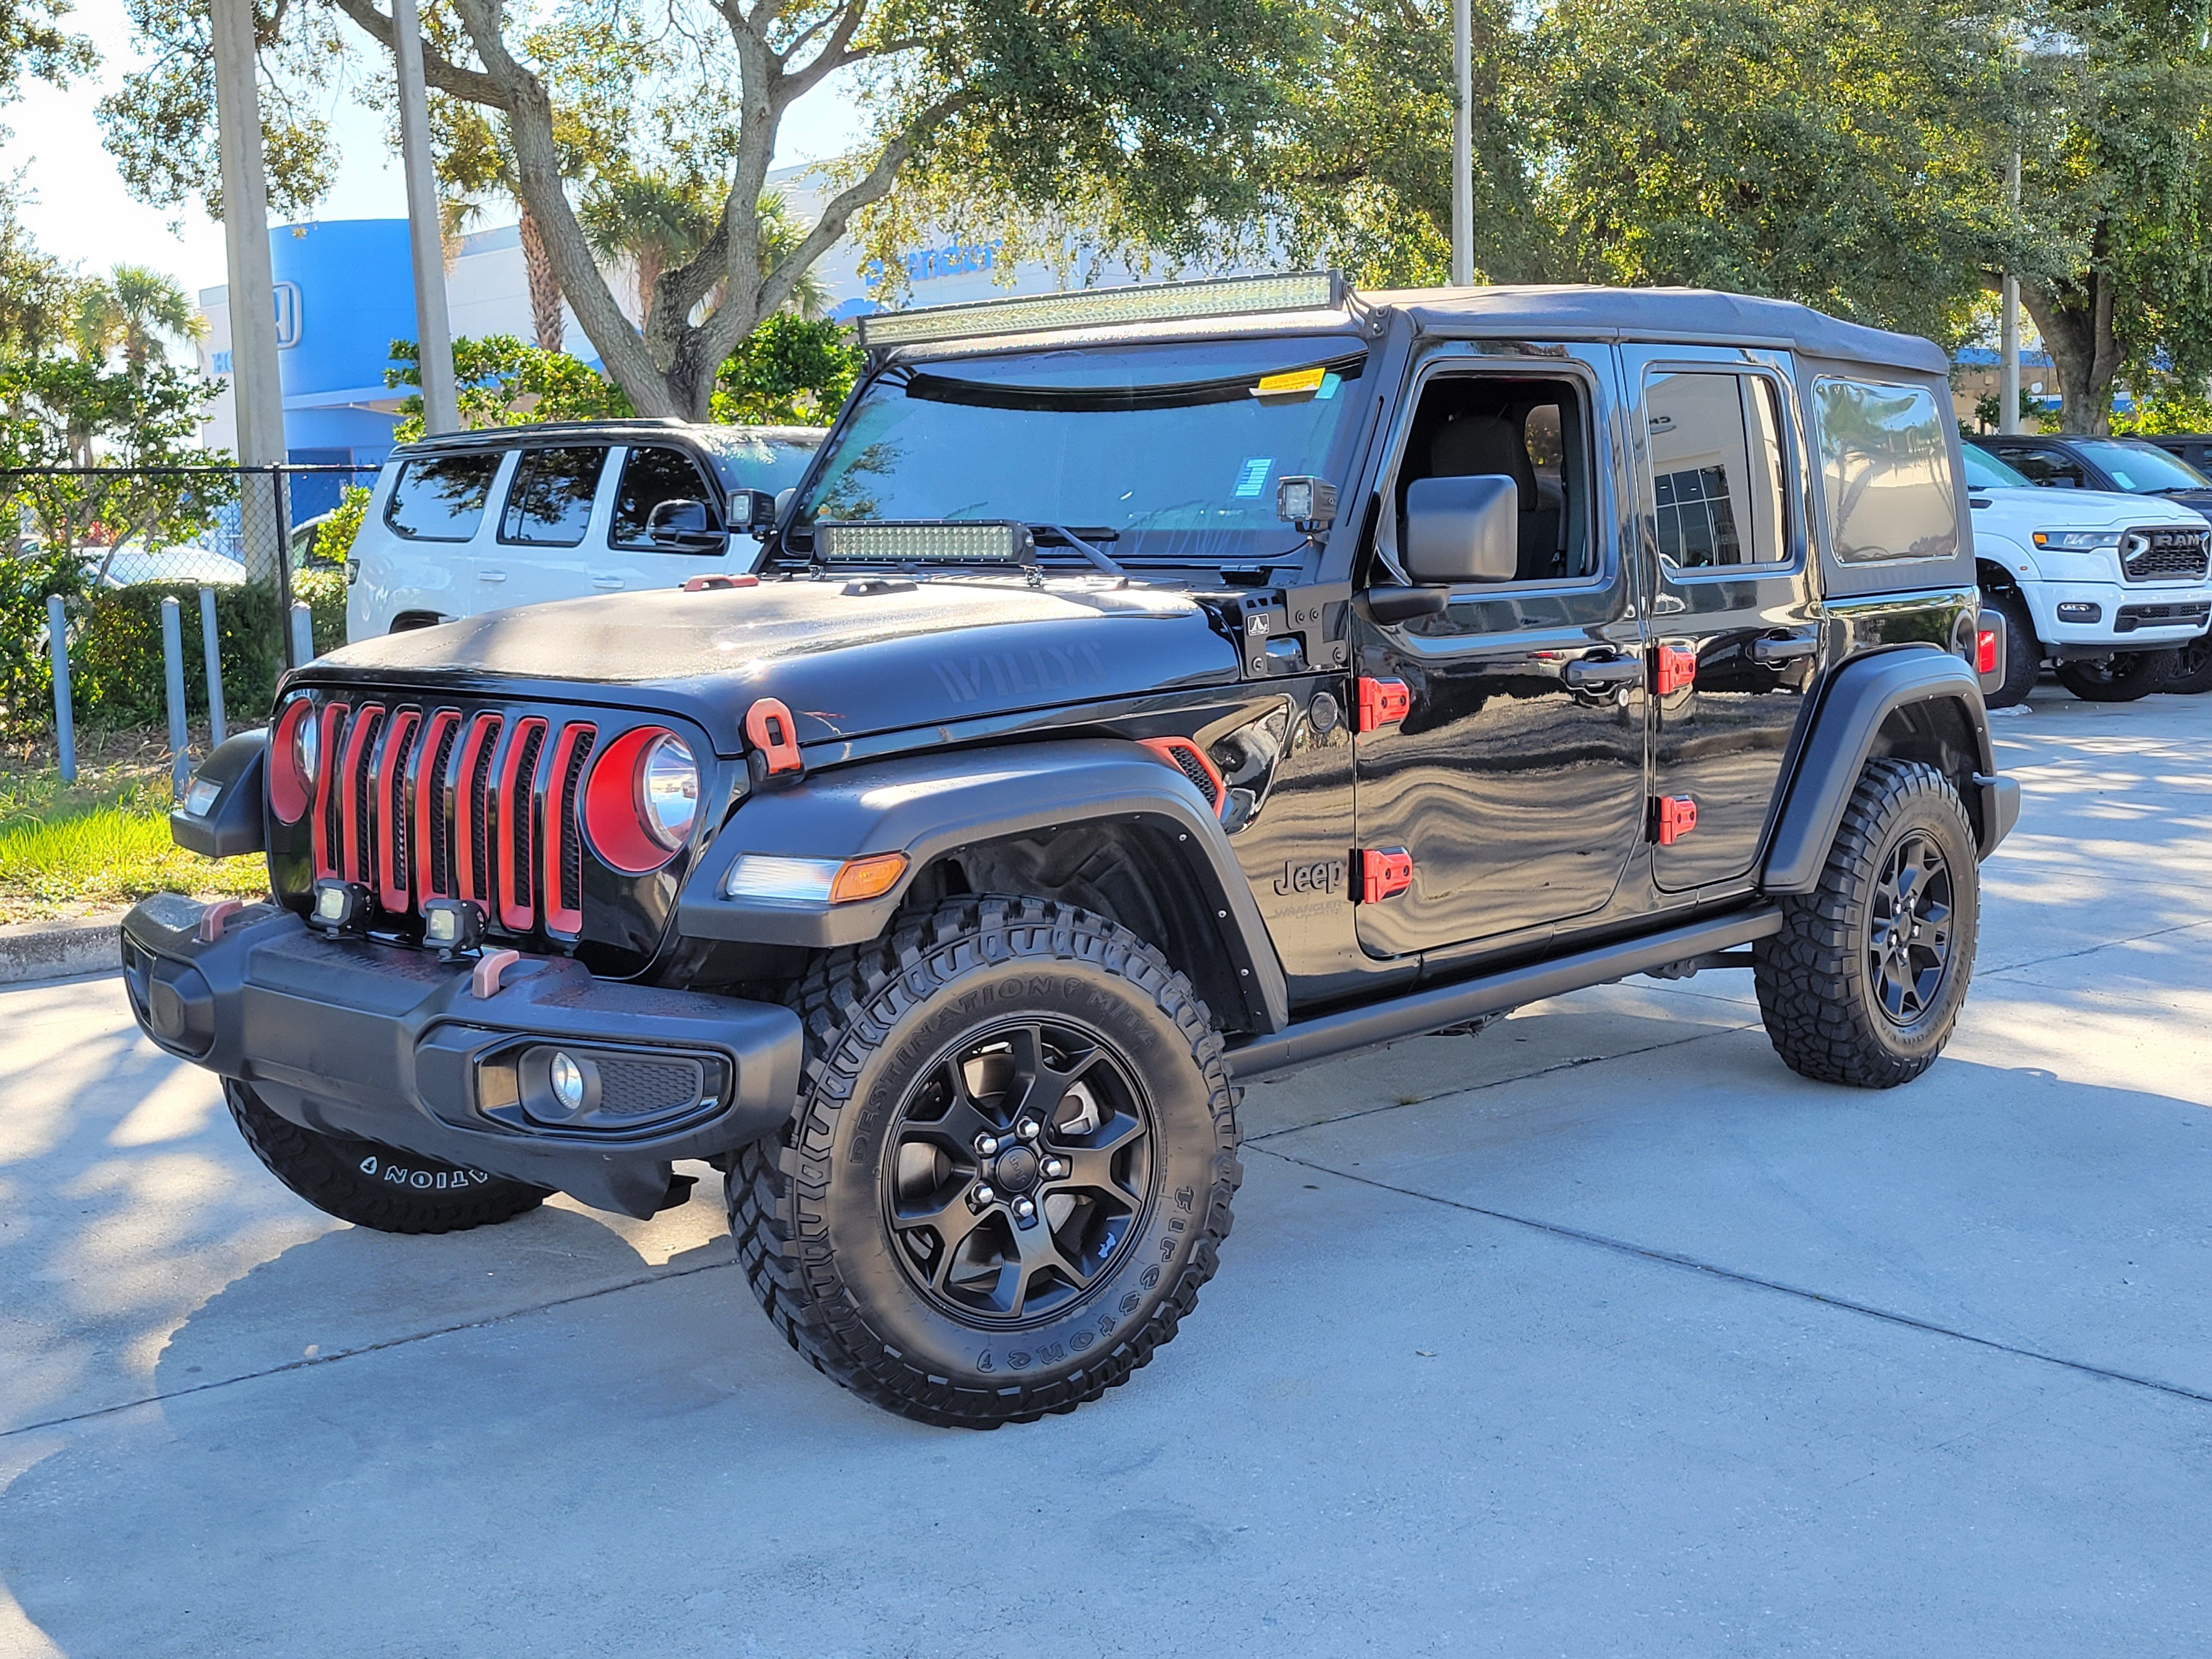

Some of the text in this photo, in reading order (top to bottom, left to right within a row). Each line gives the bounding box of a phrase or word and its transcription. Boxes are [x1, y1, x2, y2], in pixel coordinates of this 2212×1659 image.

[2154, 534, 2200, 547] RAM
[928, 641, 1108, 703] WILLYS
[1273, 860, 1345, 896] Jeep
[1274, 899, 1342, 917] WRANGLER
[849, 975, 1055, 1165] DESTINATION
[1008, 1155, 1028, 1183] Jeep
